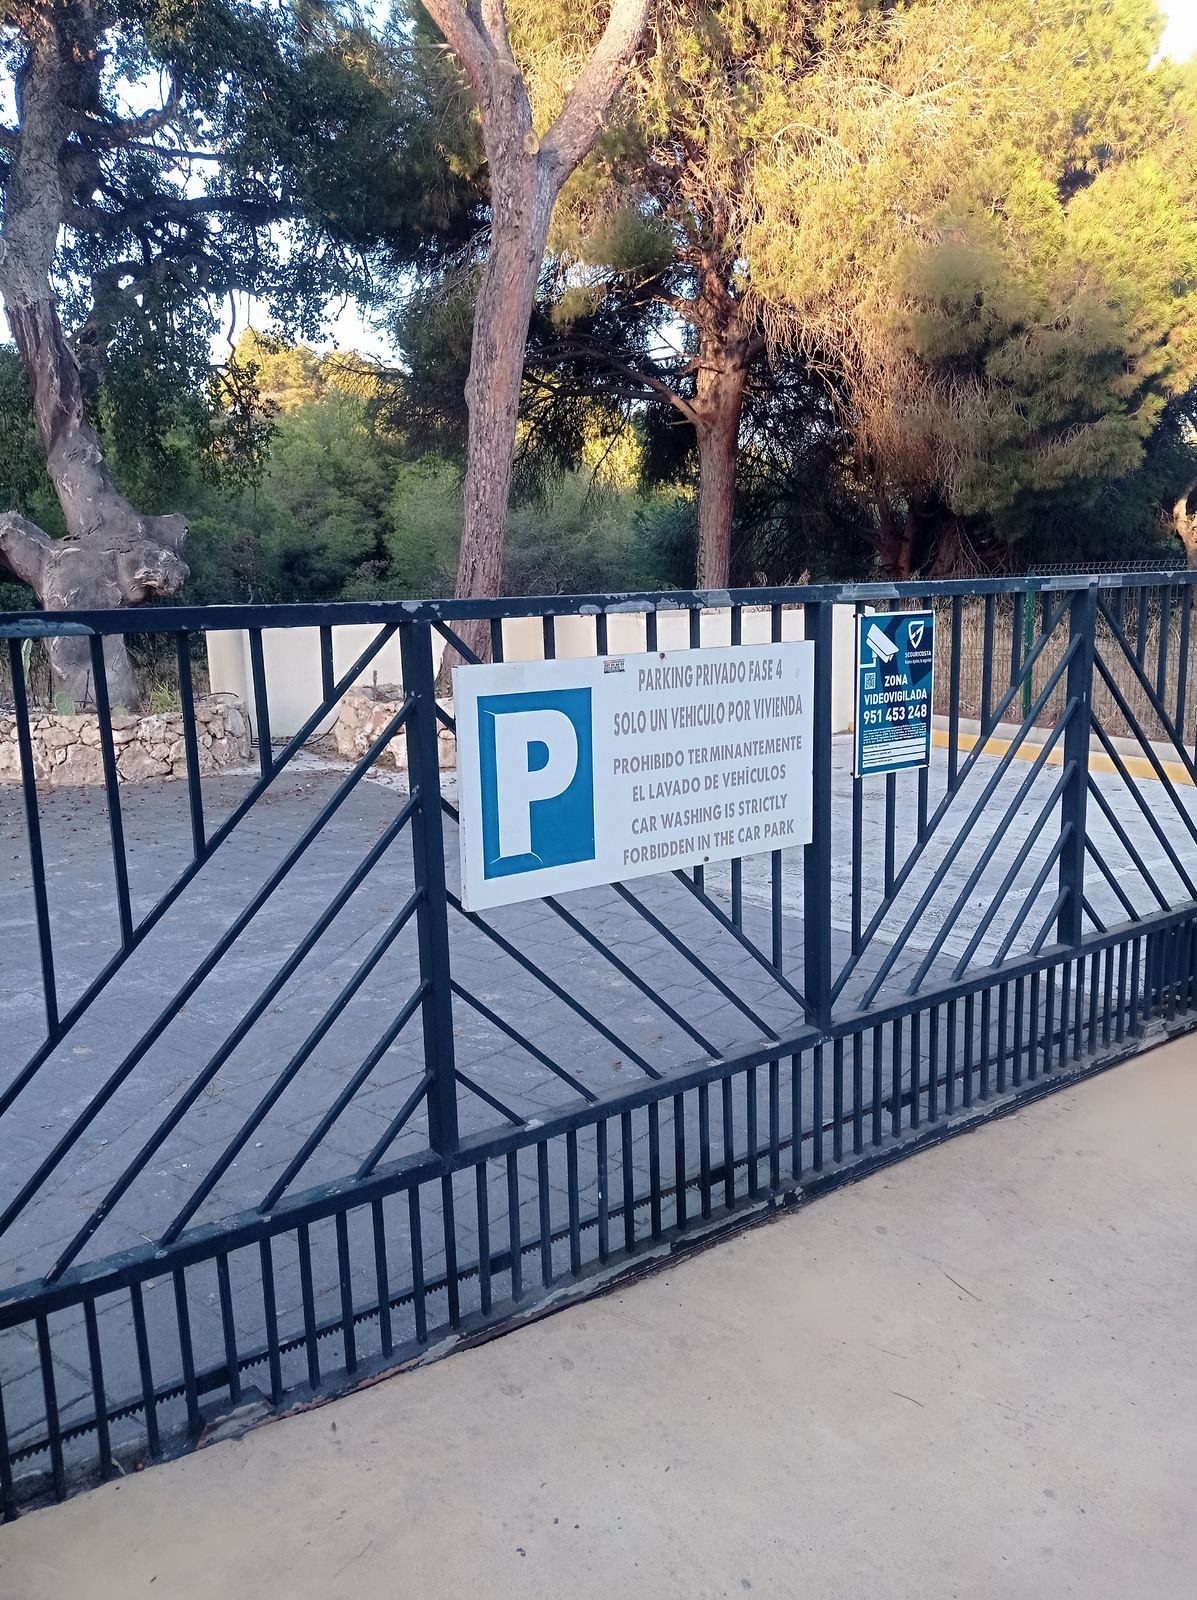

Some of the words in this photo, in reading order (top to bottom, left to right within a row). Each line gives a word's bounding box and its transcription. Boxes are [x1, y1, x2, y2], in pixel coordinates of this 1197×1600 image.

[905, 650, 931, 658] SEGURICOSTA
[638, 664, 692, 692] PARKING
[696, 661, 746, 688] PRIVADO
[749, 659, 772, 682] FASE
[776, 659, 783, 680] 4
[884, 673, 908, 687] ZONA
[614, 711, 646, 736] SOLO
[650, 709, 668, 731] UN
[671, 702, 724, 729] VEHICULO
[728, 700, 751, 723] POR
[753, 694, 802, 719] VIVIENDA
[863, 709, 882, 725] 951
[885, 706, 905, 722] 453
[908, 704, 927, 719] 248
[864, 688, 927, 706] VIDEOVIGILADA
[613, 750, 684, 775] PROHIBIDO
[688, 735, 802, 765] TERMINANTEMENTE
[495, 709, 578, 858] P
[632, 786, 646, 802] EL
[648, 776, 700, 800] LAVADO
[704, 774, 719, 791] DE
[722, 764, 786, 788] VEHÍCULOS
[631, 817, 657, 835] CAR
[661, 805, 722, 830] WASHING
[724, 803, 735, 819] IS
[738, 794, 788, 817] STRICTLY
[623, 838, 695, 865] FORBIDDEN
[698, 832, 711, 850] IN
[714, 828, 735, 847] THE
[738, 824, 761, 842] CAR
[764, 819, 794, 838] PARK
